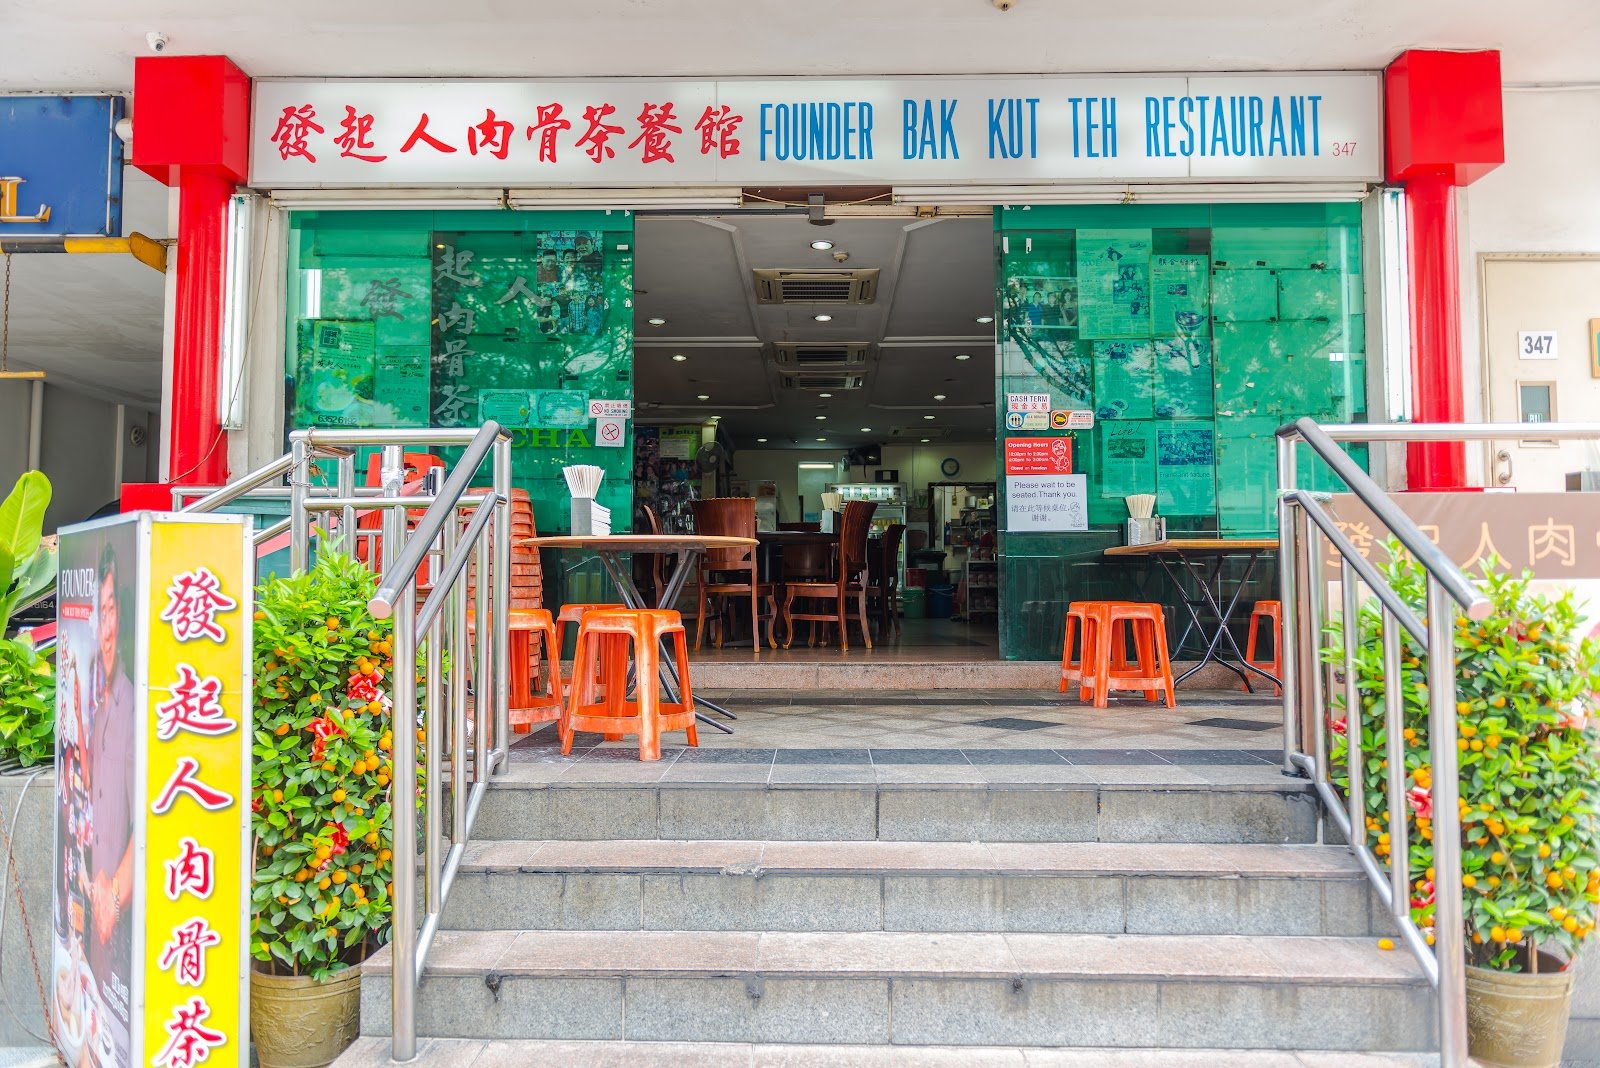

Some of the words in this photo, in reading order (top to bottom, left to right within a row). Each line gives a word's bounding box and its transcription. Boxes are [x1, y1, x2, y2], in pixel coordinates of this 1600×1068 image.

[270, 102, 744, 164] 發起人肉骨茶餐館
[760, 101, 874, 161] FOUNDER
[902, 99, 960, 160] BAK
[988, 98, 1040, 159] KUT
[1068, 97, 1118, 158] TEH
[1145, 95, 1322, 157] RESTAURANT
[1332, 142, 1357, 157] 347
[1524, 335, 1553, 354] 347
[1110, 422, 1142, 440] Life!
[1014, 481, 1039, 489] Please
[61, 568, 95, 598] FOUNDER
[154, 570, 235, 1068] 發起人肉骨茶
